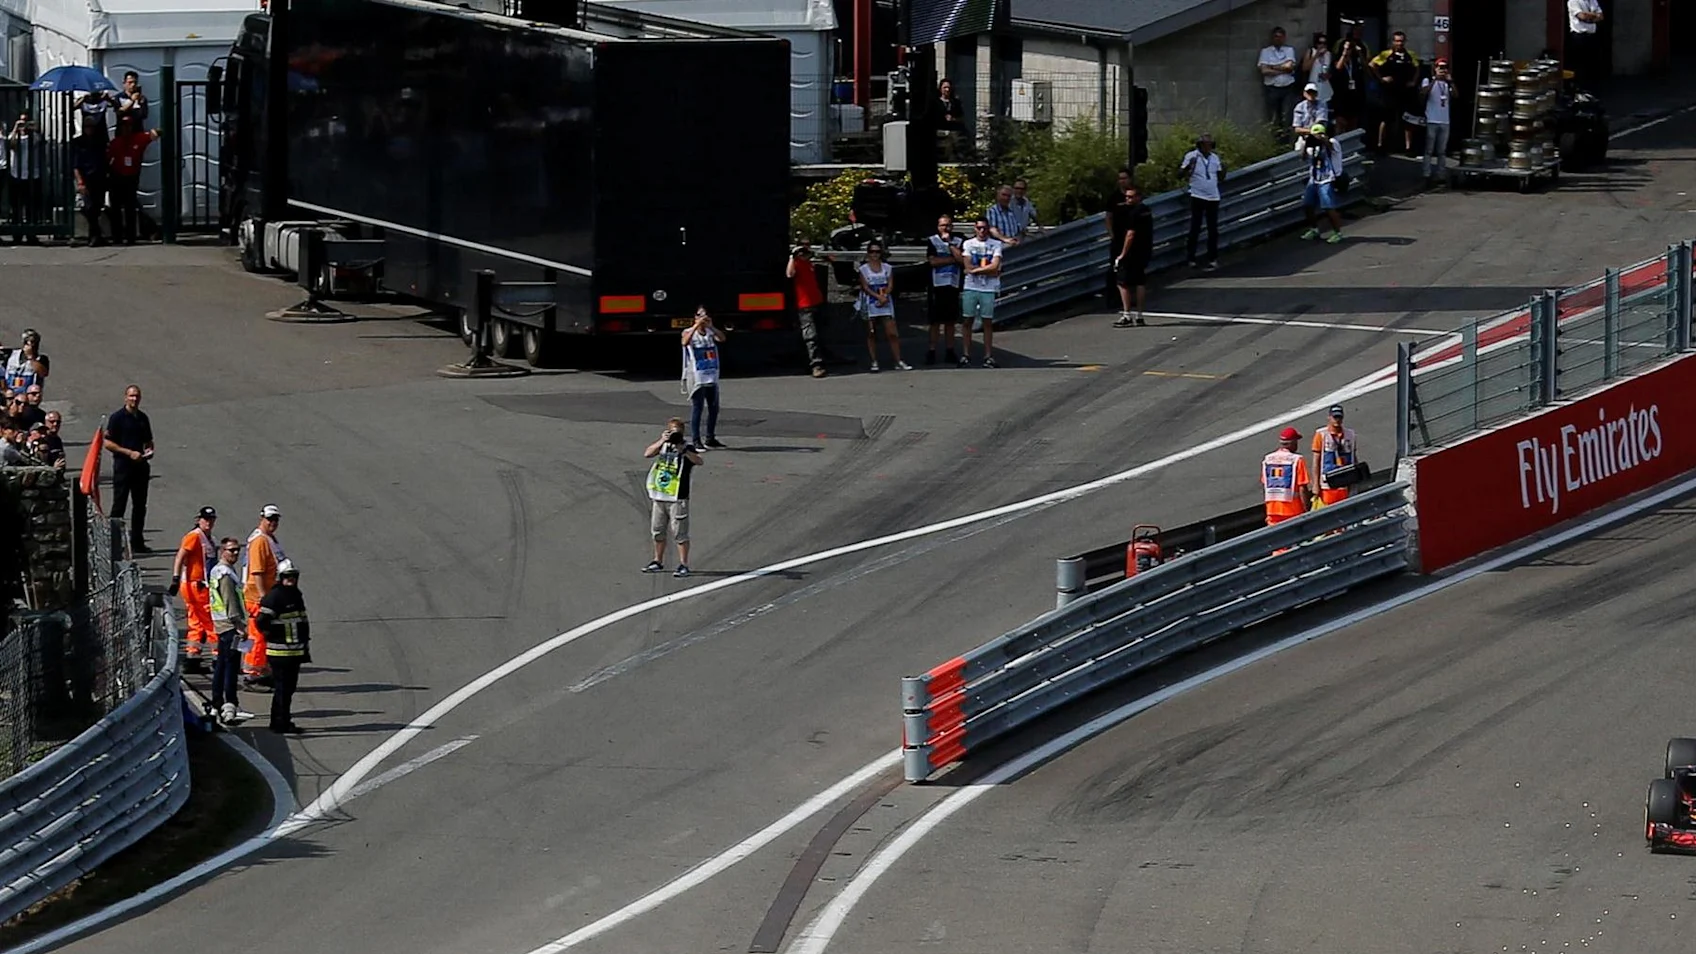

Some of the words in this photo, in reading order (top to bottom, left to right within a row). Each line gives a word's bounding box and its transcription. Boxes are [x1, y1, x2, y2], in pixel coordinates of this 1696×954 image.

[1434, 19, 1449, 29] 46
[1516, 435, 1558, 514] Fly
[1561, 402, 1663, 492] Emirates
